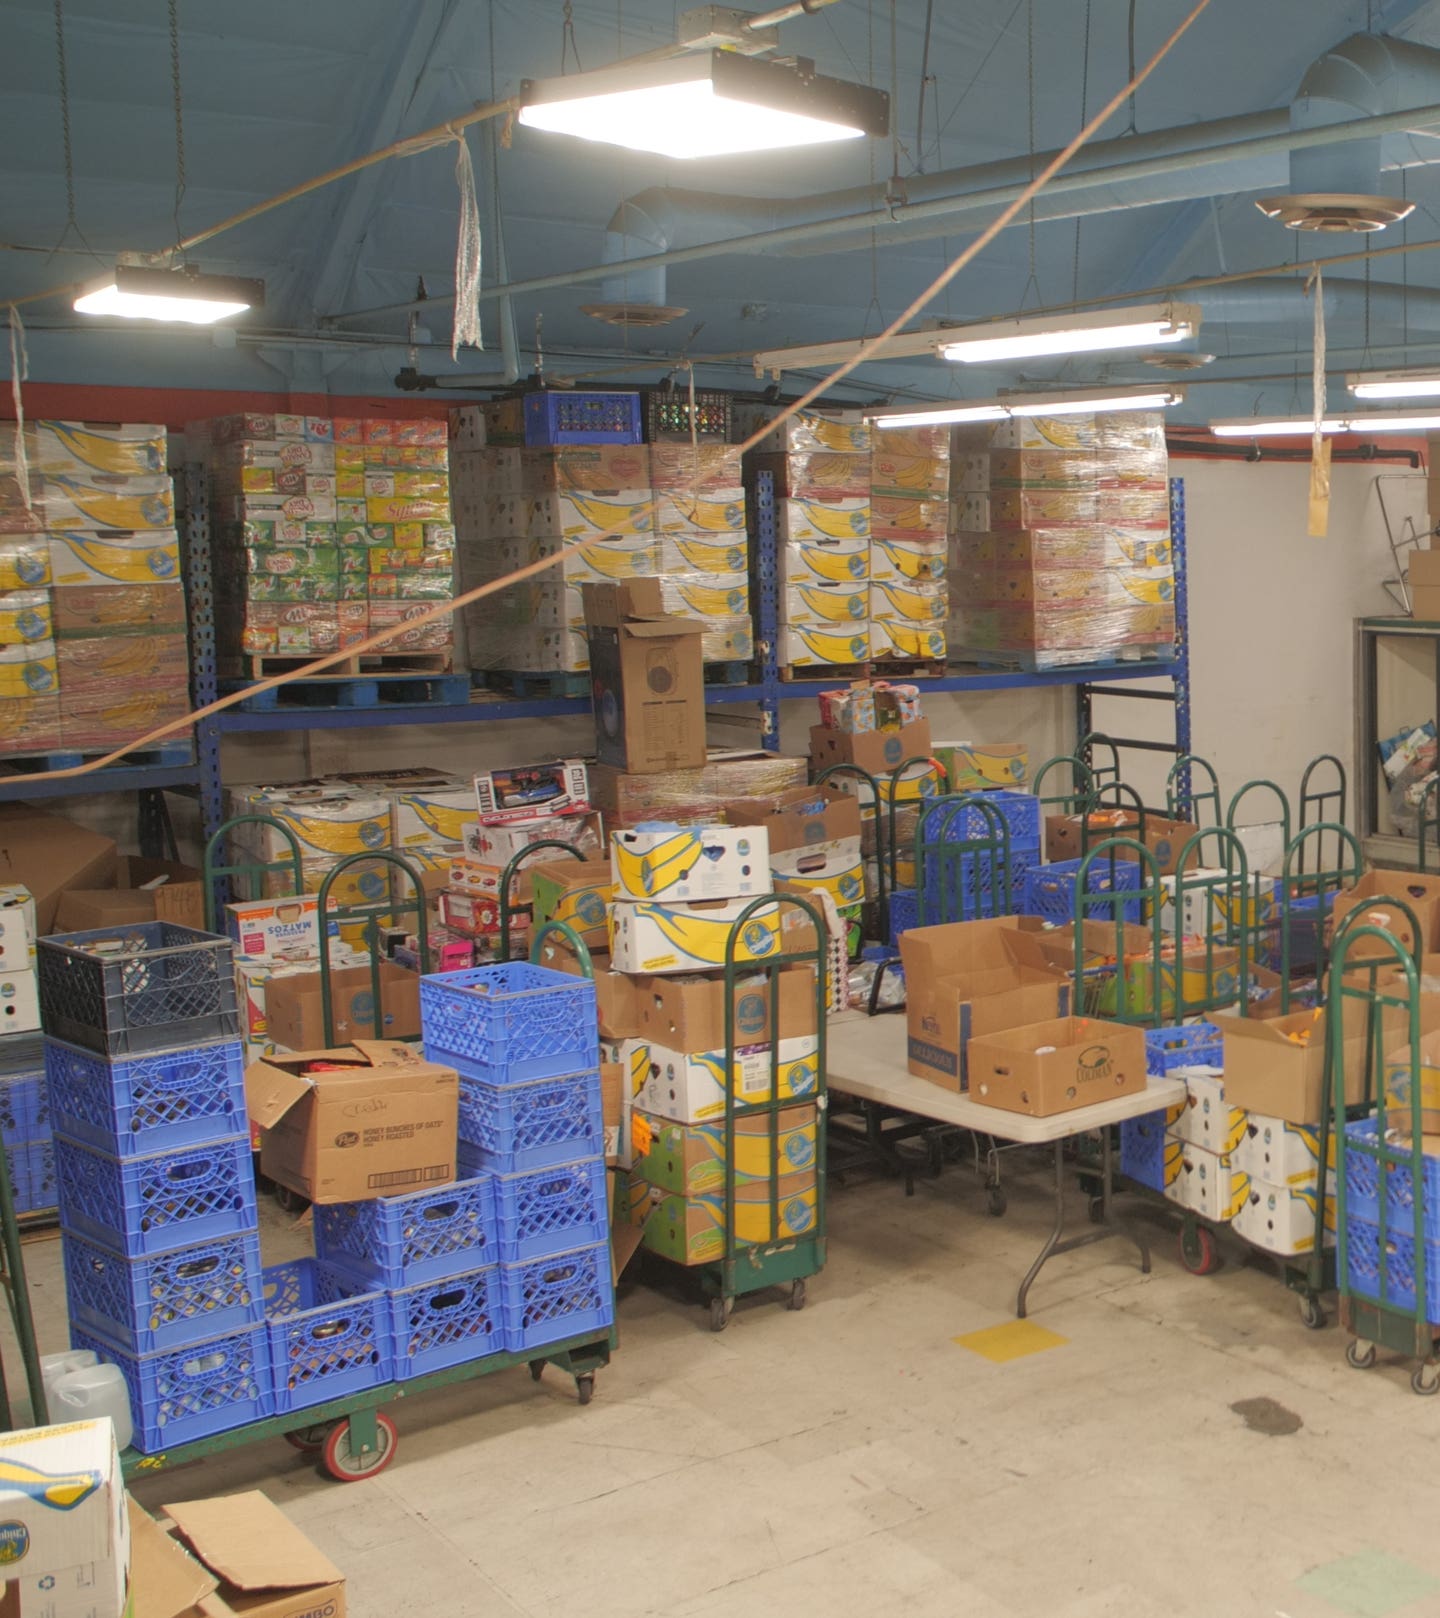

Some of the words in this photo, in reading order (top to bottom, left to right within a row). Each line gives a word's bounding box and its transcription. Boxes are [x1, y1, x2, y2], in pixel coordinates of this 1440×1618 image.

[267, 921, 312, 935] MATZOS
[386, 1124, 415, 1133] BUNCHES
[386, 1131, 415, 1140] ROASTED
